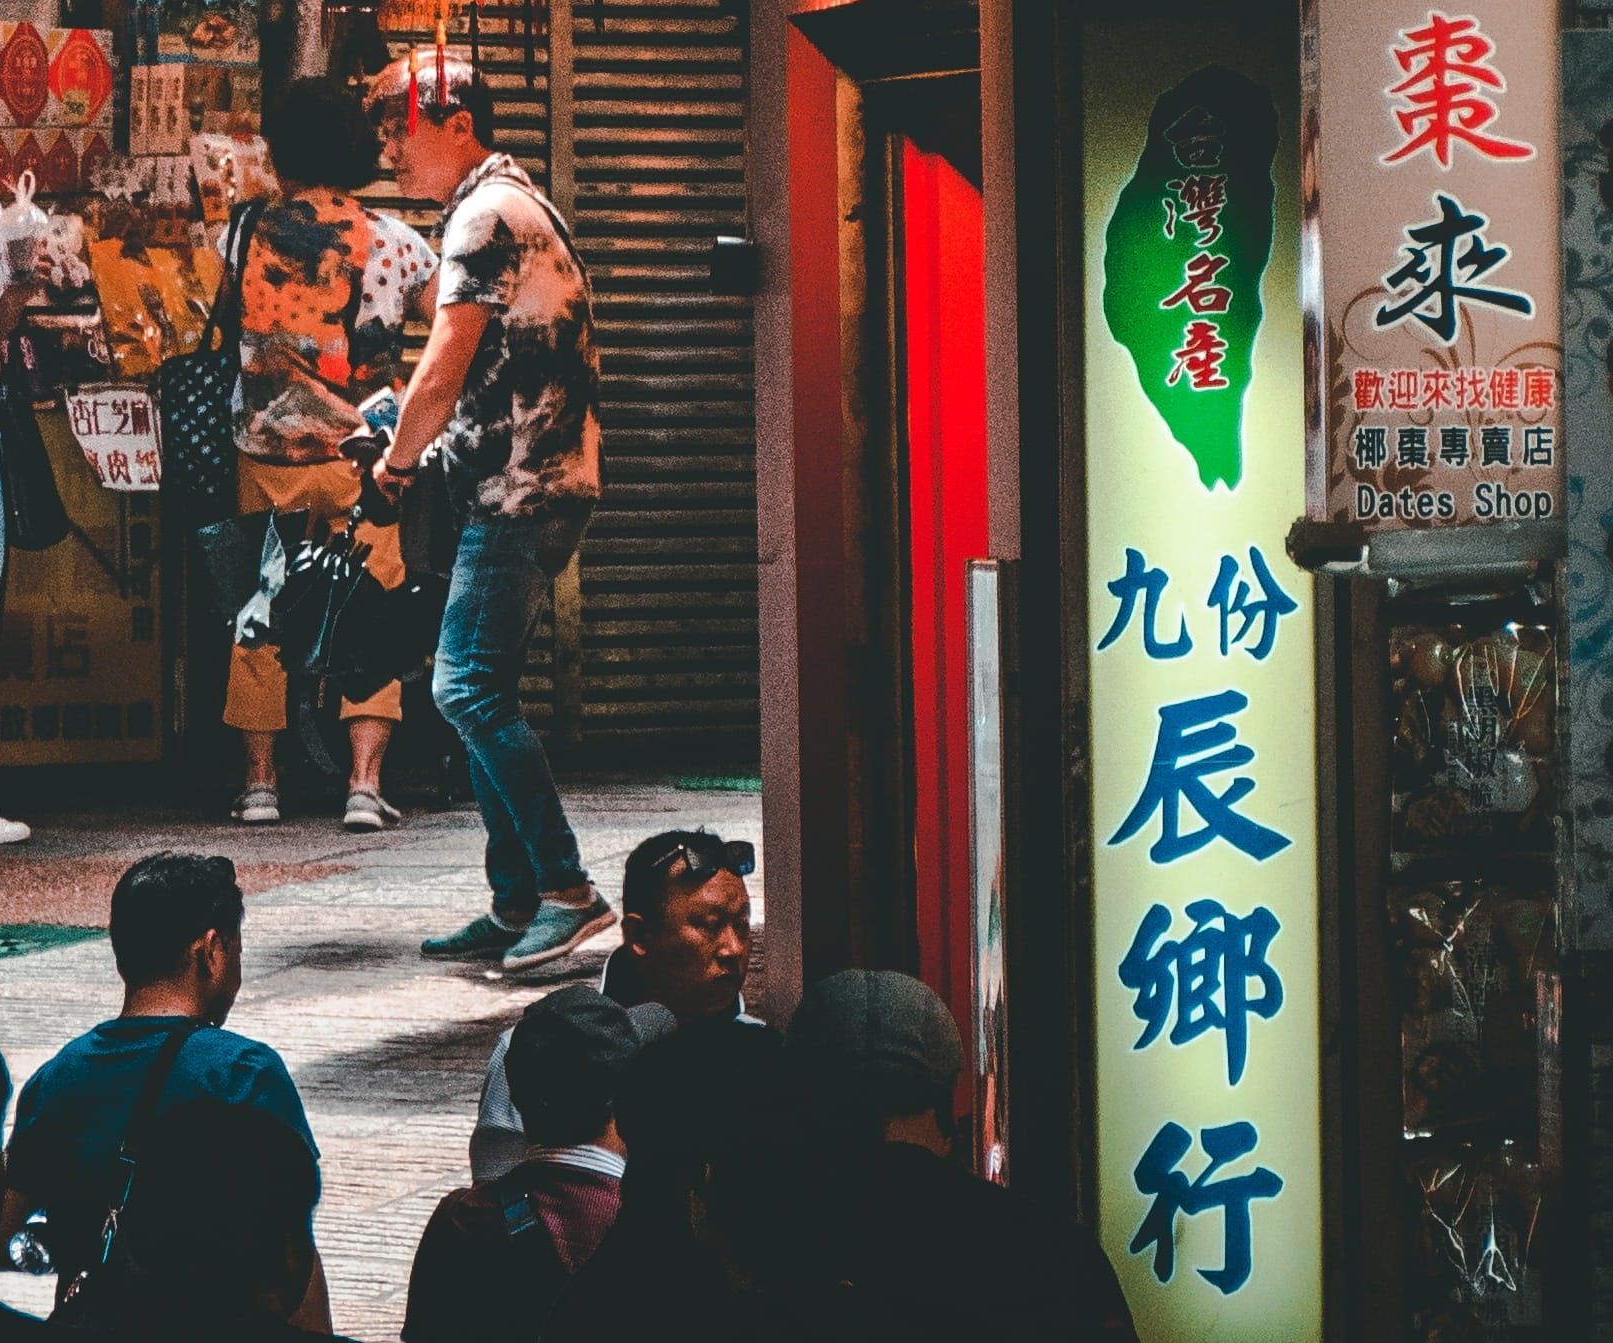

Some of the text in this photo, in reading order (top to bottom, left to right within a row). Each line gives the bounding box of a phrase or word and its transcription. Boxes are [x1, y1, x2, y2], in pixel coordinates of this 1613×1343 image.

[1159, 105, 1233, 391] 台灣名產
[1354, 369, 1555, 412] 歡迎來找健康
[1355, 426, 1554, 468] 椰棗專賣店
[1357, 483, 1553, 520] Dates Shop
[1097, 546, 1298, 660] 九份
[1107, 689, 1293, 1295] 辰鄉行
